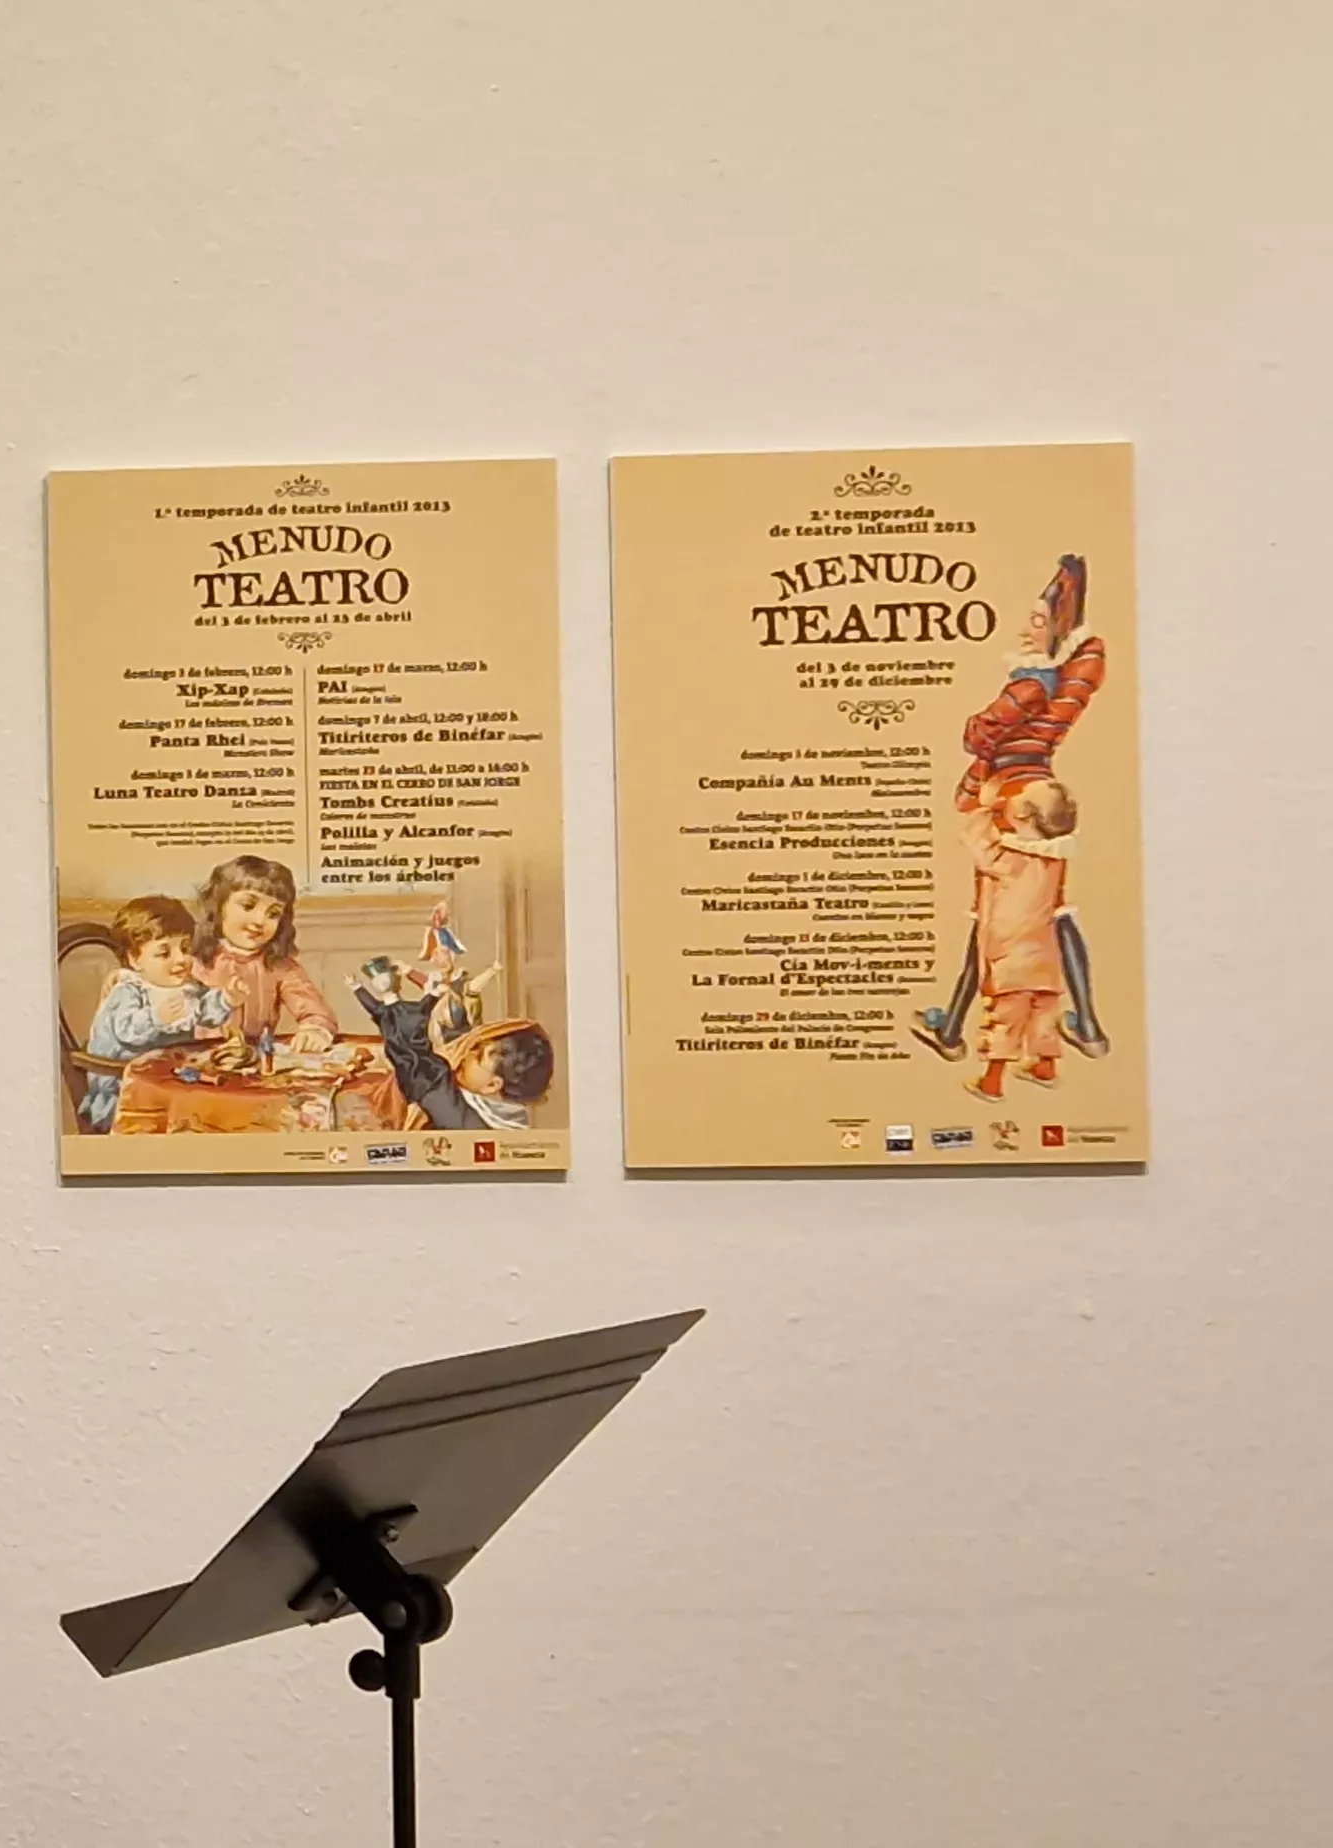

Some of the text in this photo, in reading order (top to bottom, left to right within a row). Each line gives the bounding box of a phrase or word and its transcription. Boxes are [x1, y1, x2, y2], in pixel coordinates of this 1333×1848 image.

[176, 506, 263, 518] temporada
[268, 504, 286, 515] de
[292, 505, 342, 514] teatro
[346, 501, 408, 513] infantil
[413, 502, 450, 512] 2013
[835, 508, 934, 522] temporada
[769, 520, 976, 537] de teatro infantil 2013
[210, 526, 393, 570] MENUDO
[771, 553, 978, 602] MENUDO
[194, 569, 409, 607] TEATRO
[195, 616, 216, 626] del
[234, 615, 250, 625] de
[255, 615, 310, 624] febrero
[315, 613, 327, 623] al
[354, 613, 371, 622] de
[376, 611, 411, 621] abril
[752, 602, 996, 645] TEATRO
[317, 665, 370, 676] domingo
[387, 663, 401, 673] de
[479, 661, 487, 671] h
[797, 662, 821, 673] del
[841, 662, 860, 672] de
[865, 660, 955, 671] noviembre
[318, 681, 347, 693] PAI
[800, 677, 814, 688] al
[844, 676, 862, 687] de
[868, 675, 952, 686] diciembre
[176, 684, 249, 700] Xip-Xap
[119, 720, 171, 731] domingo
[188, 718, 202, 728] de
[285, 716, 293, 726] h
[318, 716, 371, 727] domingo
[383, 714, 397, 724] de
[466, 715, 473, 725] y
[510, 711, 518, 721] h
[150, 736, 200, 747] Panta
[206, 734, 245, 746] Rhei
[318, 729, 505, 744] Titiriteros de Binéfar
[362, 780, 378, 789] EN
[438, 778, 453, 788] DE
[456, 778, 481, 787] SAN
[699, 775, 871, 791] Compañía Au Ments
[94, 785, 257, 799] Luna Teatro Danza
[320, 796, 375, 808] Tombs
[736, 811, 789, 823] domingo
[806, 811, 820, 819] de
[924, 808, 931, 817] h
[321, 825, 474, 841] Polilla y Alcanfor
[710, 836, 895, 850] Esencia Producciones
[321, 856, 480, 871] Animación y juegos
[322, 867, 456, 883] entre los árboles
[702, 898, 869, 911] Maricastaña Teatro
[814, 959, 919, 970] Mov-i-ments
[925, 960, 935, 972] y
[692, 975, 713, 986] La
[718, 974, 774, 985] Fornal
[701, 1013, 753, 1026] domingo
[772, 1012, 786, 1021] de
[886, 1010, 894, 1020] h
[676, 1036, 860, 1051] Titiriteros de Binéfar
